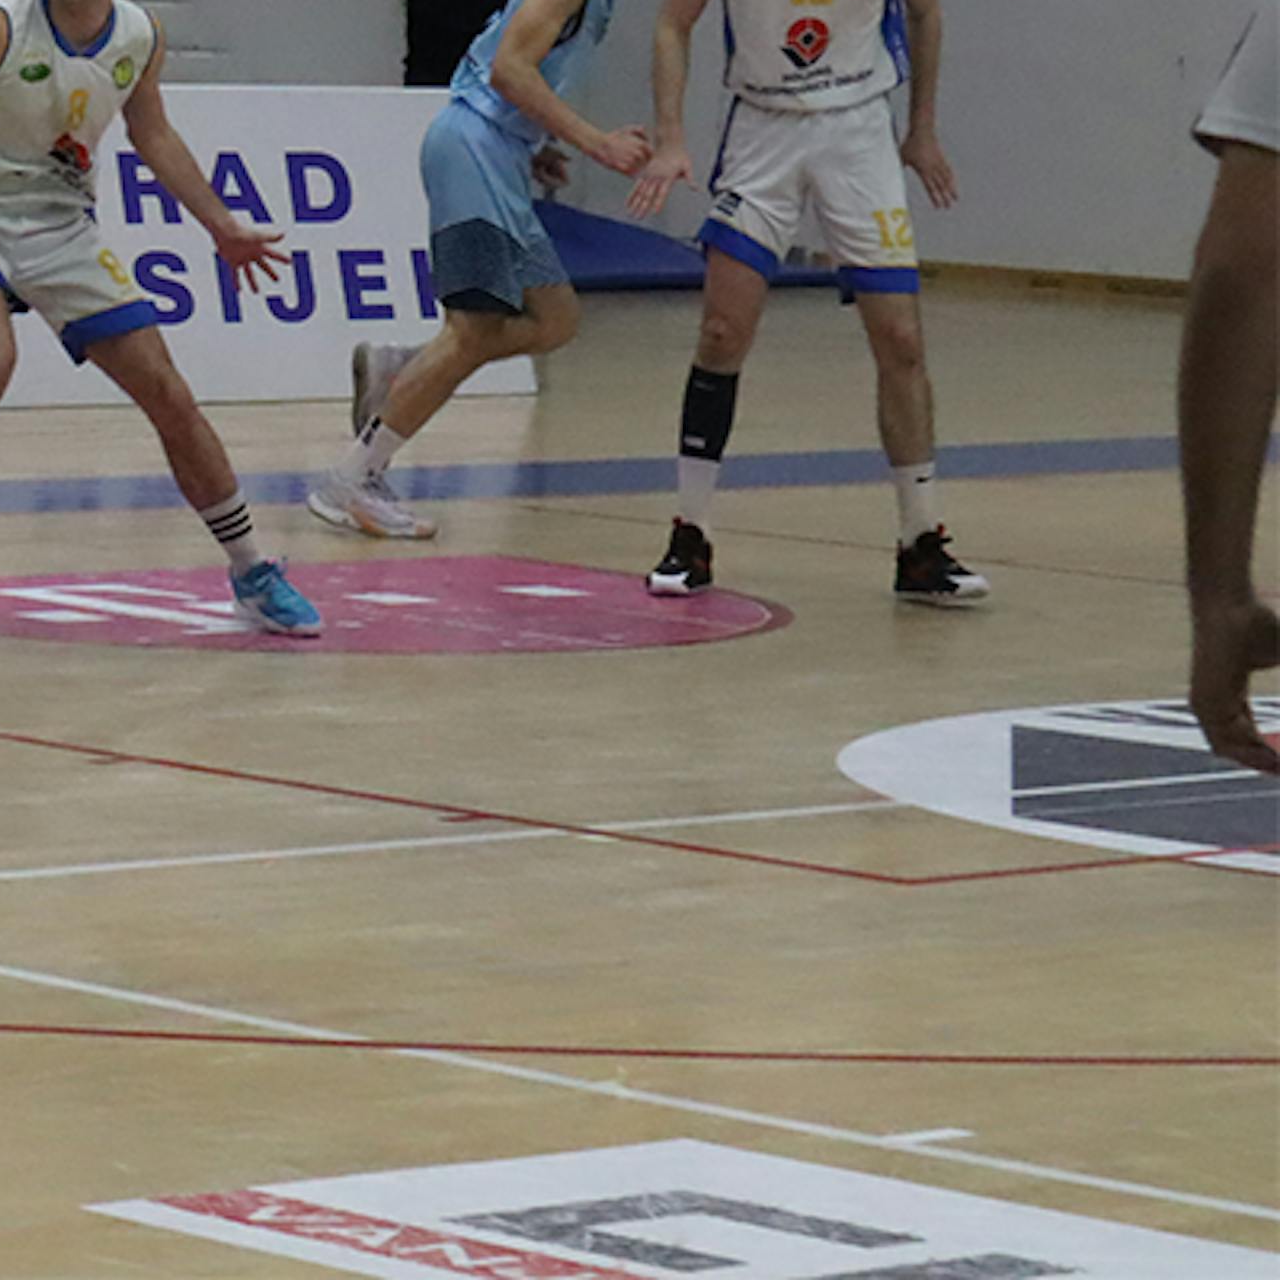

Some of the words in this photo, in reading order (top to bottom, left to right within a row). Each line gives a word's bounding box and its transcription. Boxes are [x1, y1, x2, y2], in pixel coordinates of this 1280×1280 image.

[66, 89, 90, 132] 8
[116, 151, 353, 223] RAD
[872, 208, 915, 250] 12
[133, 249, 439, 325] SIJE
